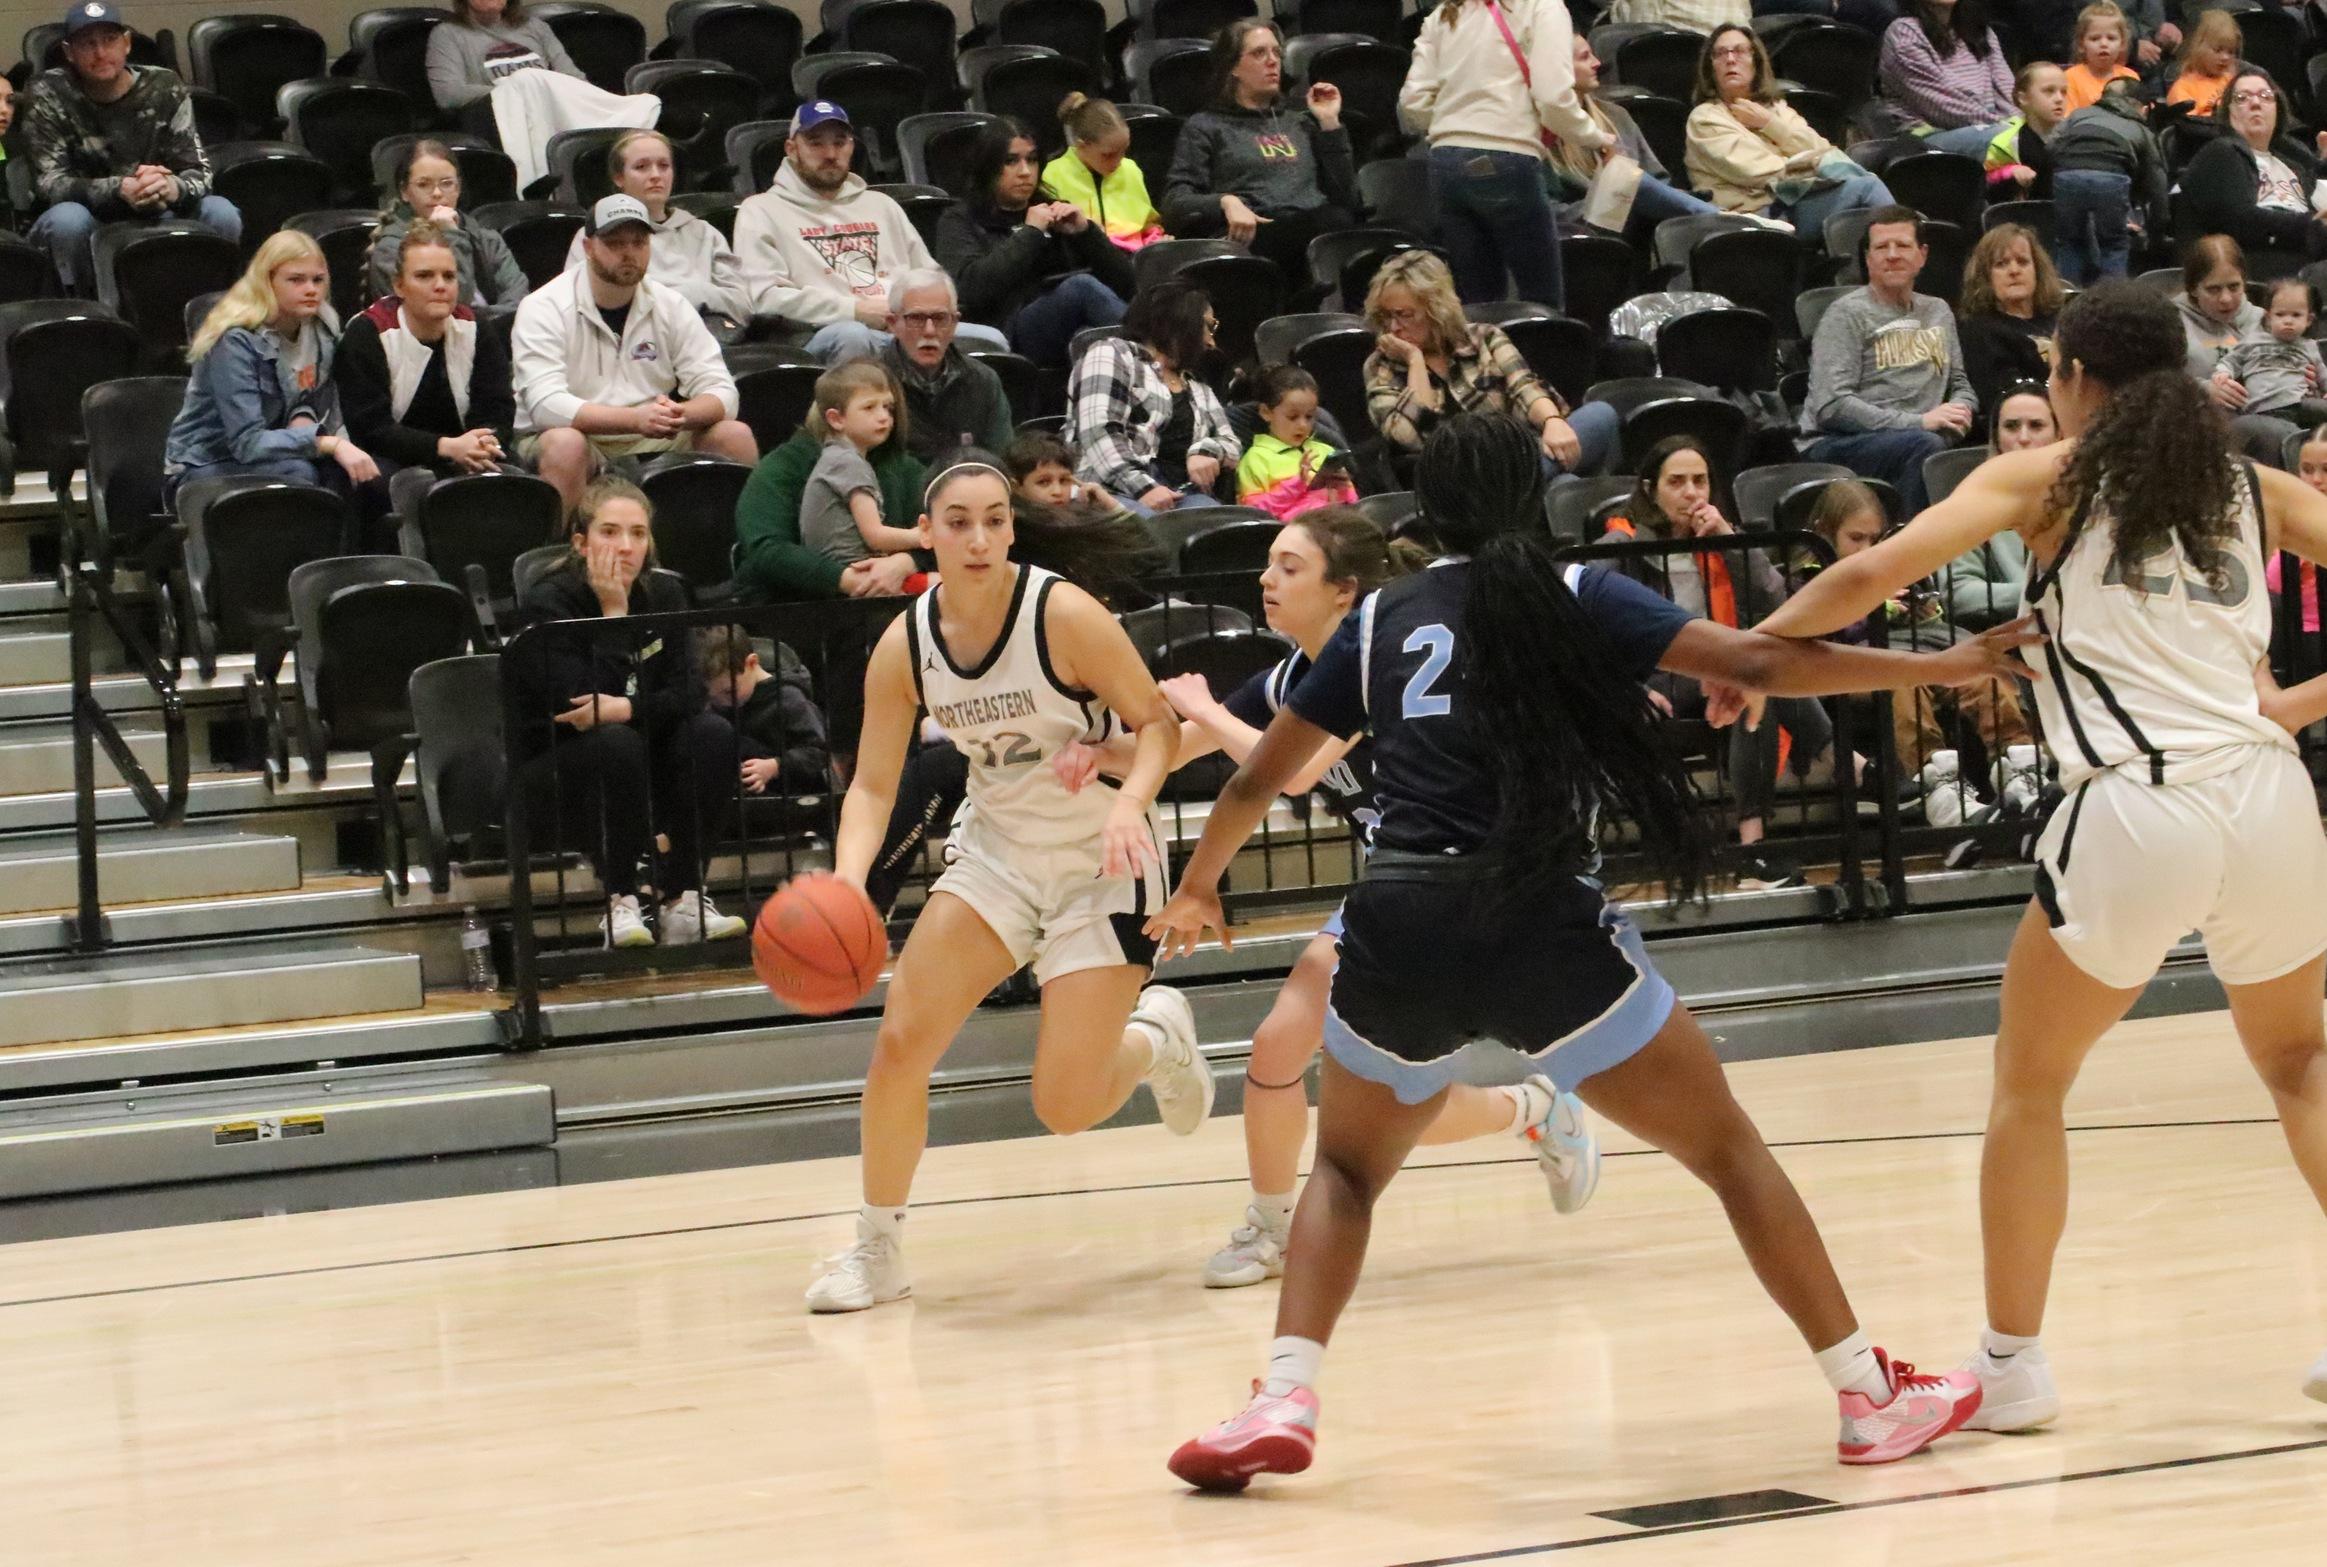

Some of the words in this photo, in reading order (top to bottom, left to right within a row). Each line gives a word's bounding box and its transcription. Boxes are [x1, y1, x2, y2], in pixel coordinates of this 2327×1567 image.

[799, 225, 828, 237] LADY
[1402, 623, 1454, 720] 2
[932, 689, 1038, 729] NORTHEASTERN
[967, 731, 1042, 768] 12
